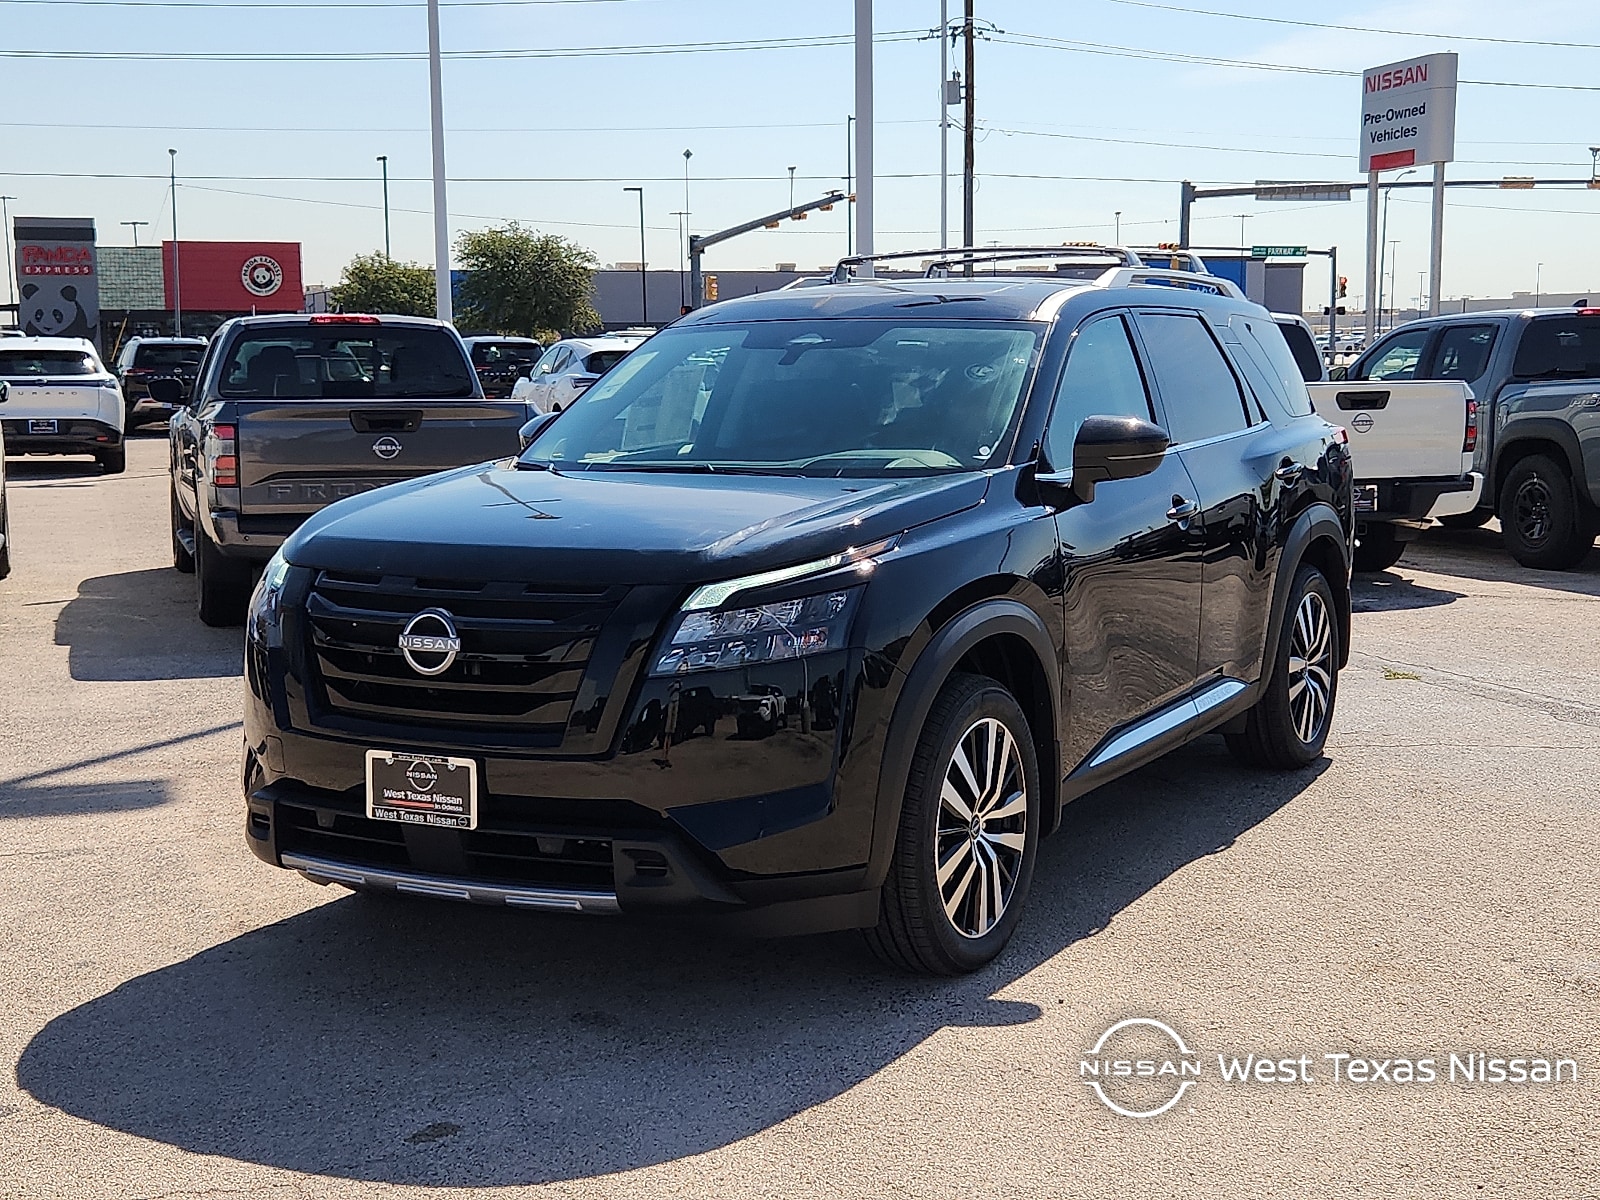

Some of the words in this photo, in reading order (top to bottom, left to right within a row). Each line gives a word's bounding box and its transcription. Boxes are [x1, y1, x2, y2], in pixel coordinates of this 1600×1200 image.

[1365, 63, 1428, 94] NISSAN
[1363, 102, 1426, 126] Pre-Owned
[1370, 126, 1418, 143] Vehicles
[22, 245, 92, 263] PANDA
[1267, 247, 1294, 255] PARKWAY
[25, 266, 89, 274] EXPRESS
[242, 257, 258, 277] PANDA
[259, 257, 281, 277] EXPRESS
[399, 636, 460, 651] NISSAN
[406, 770, 438, 780] NISSAN
[383, 788, 405, 800] West
[406, 791, 432, 802] Texas
[432, 794, 463, 805] Nissan
[375, 808, 398, 819] West
[398, 811, 425, 822] Texas
[426, 813, 457, 826] Nissan
